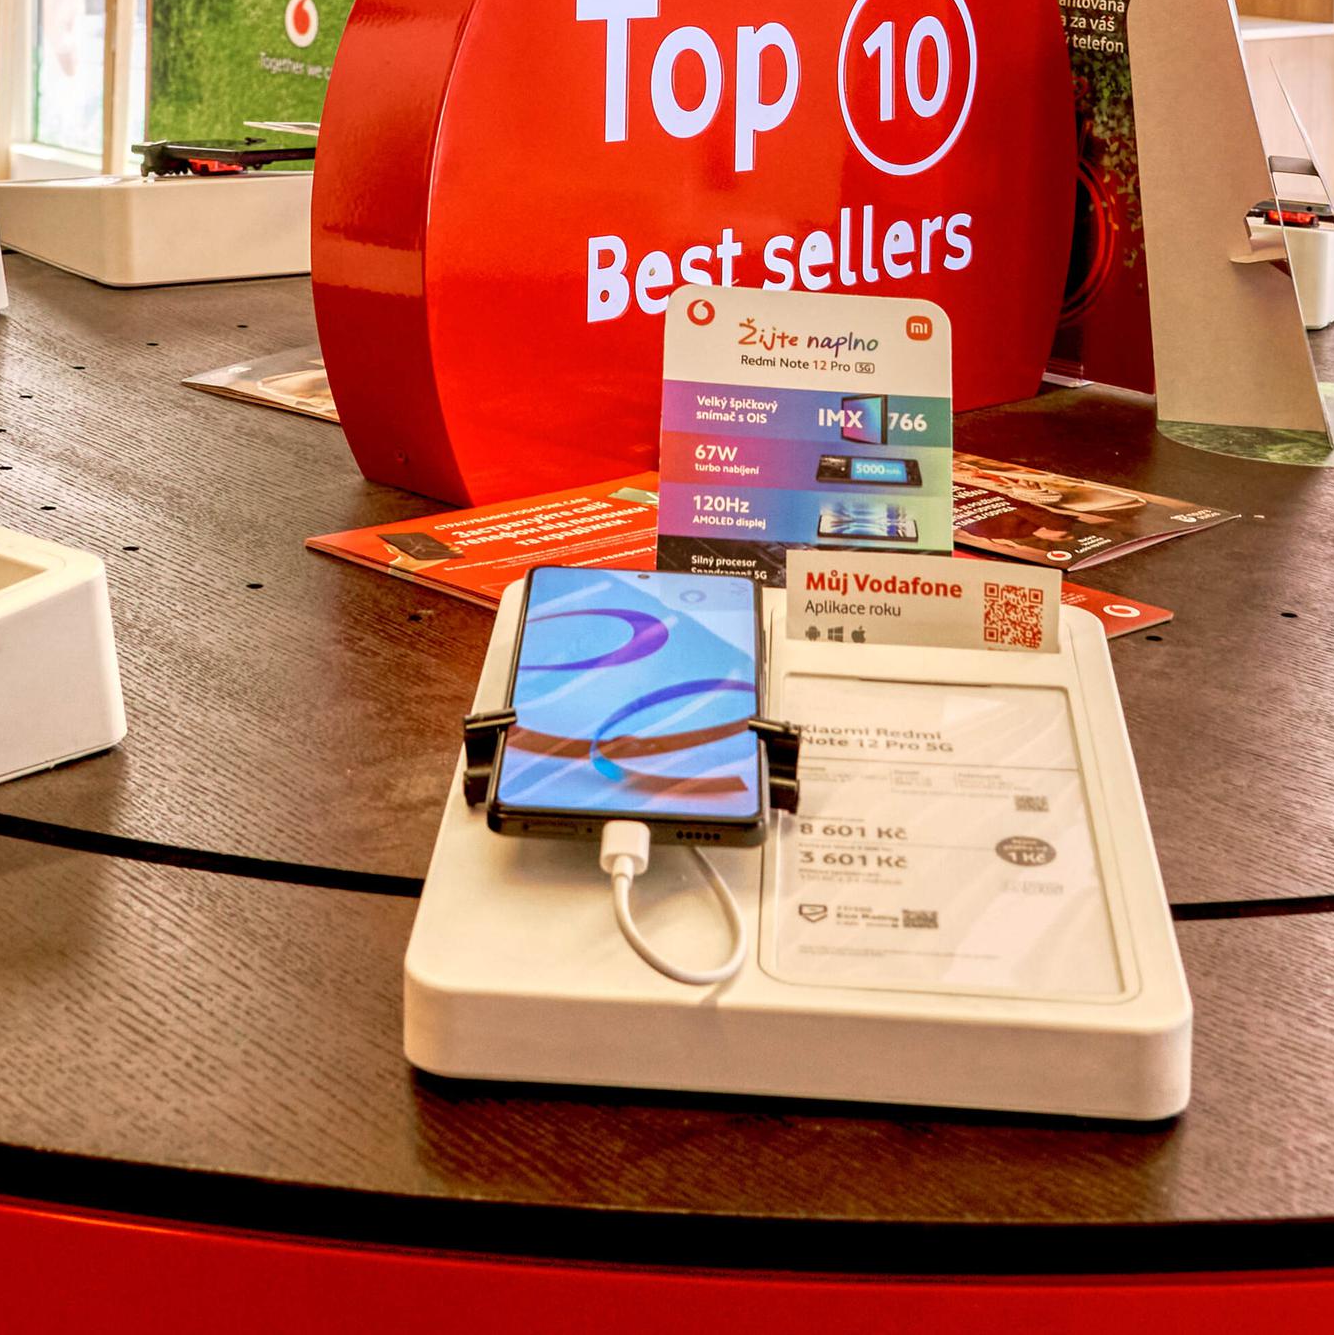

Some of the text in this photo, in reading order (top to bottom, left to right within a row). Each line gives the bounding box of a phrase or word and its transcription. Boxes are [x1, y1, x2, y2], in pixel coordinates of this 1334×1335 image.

[1070, 15, 1115, 32] za váš
[1073, 34, 1124, 53] telefon
[862, 16, 951, 121] 10
[587, 204, 972, 322] Best sellers
[738, 317, 879, 357] Žijte naplno
[741, 354, 871, 373] Redmi Note 12 Pro 5G
[697, 395, 778, 412] Velký špičkový
[696, 410, 767, 424] snímač s OIS
[818, 408, 927, 432] IMX 766
[695, 445, 738, 462] 67W
[695, 463, 760, 477] turbo nabíjení
[855, 464, 885, 475] 5000
[693, 495, 749, 513] 120Hz
[452, 506, 571, 538] Застрахуйте
[692, 516, 767, 530] AMOLED displej
[454, 526, 539, 547] телефон
[515, 535, 540, 546] та
[691, 555, 757, 568] Silný procesor
[754, 570, 767, 580] 5G
[805, 569, 963, 598] Můj Vodafone
[805, 599, 901, 617] Aplikace roku
[875, 727, 942, 740] Redmi
[800, 736, 954, 753] Note 12 Pro 5G
[799, 823, 907, 840] 8 601 Kč
[799, 851, 908, 868] 3 601 Kč
